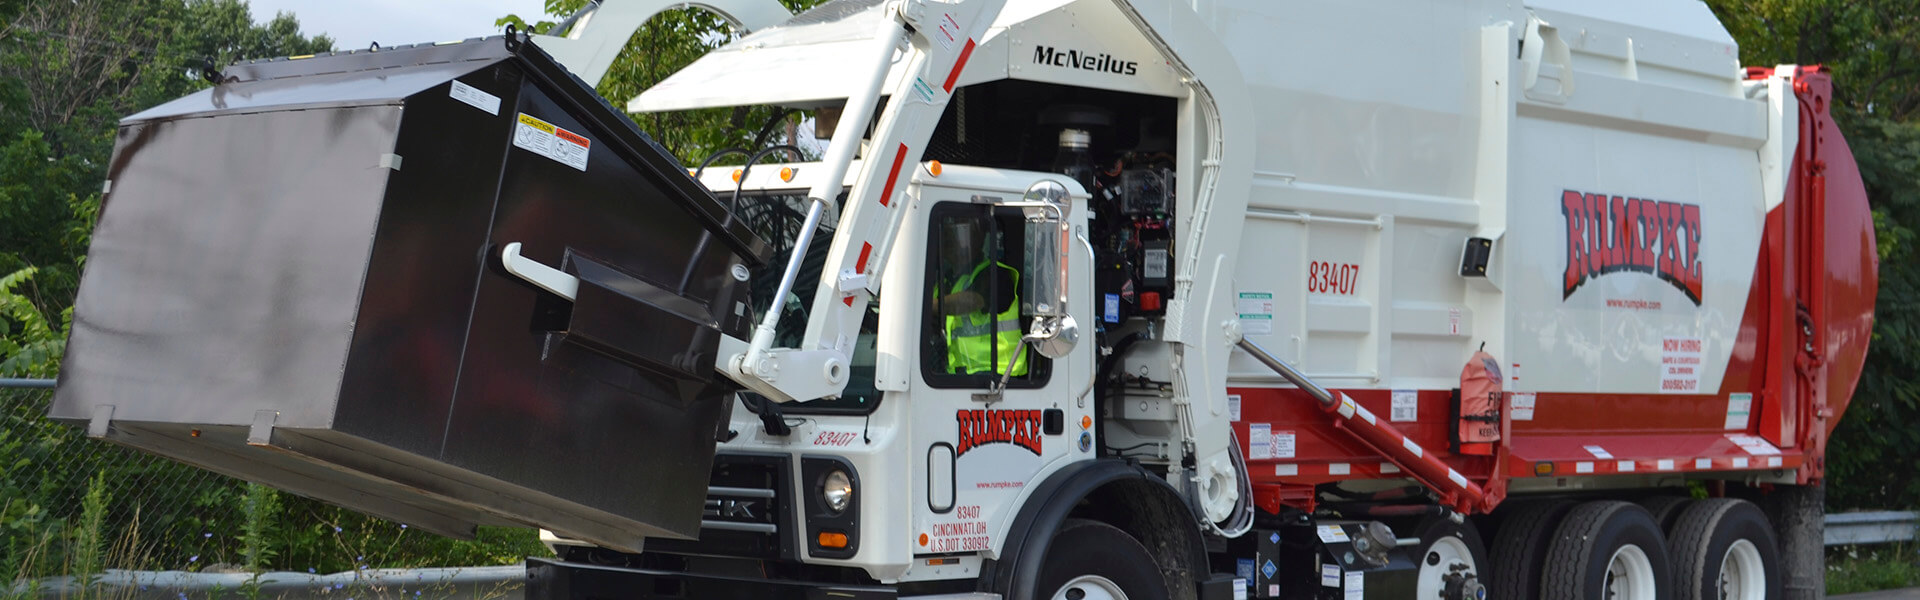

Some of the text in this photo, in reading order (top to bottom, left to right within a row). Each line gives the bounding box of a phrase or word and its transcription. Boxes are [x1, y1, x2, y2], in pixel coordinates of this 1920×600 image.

[1033, 45, 1138, 76] McNeilus
[525, 117, 553, 133] CAUTION
[1561, 189, 1702, 308] RUMPKE
[1308, 260, 1359, 295] 83407
[1606, 299, 1662, 311] www.rumpke.com
[814, 431, 857, 447] 83407
[956, 409, 1042, 460] RUMPKE
[976, 481, 1023, 489] www.rumpke.com
[957, 505, 980, 519] 83407
[962, 536, 990, 550] 330912
